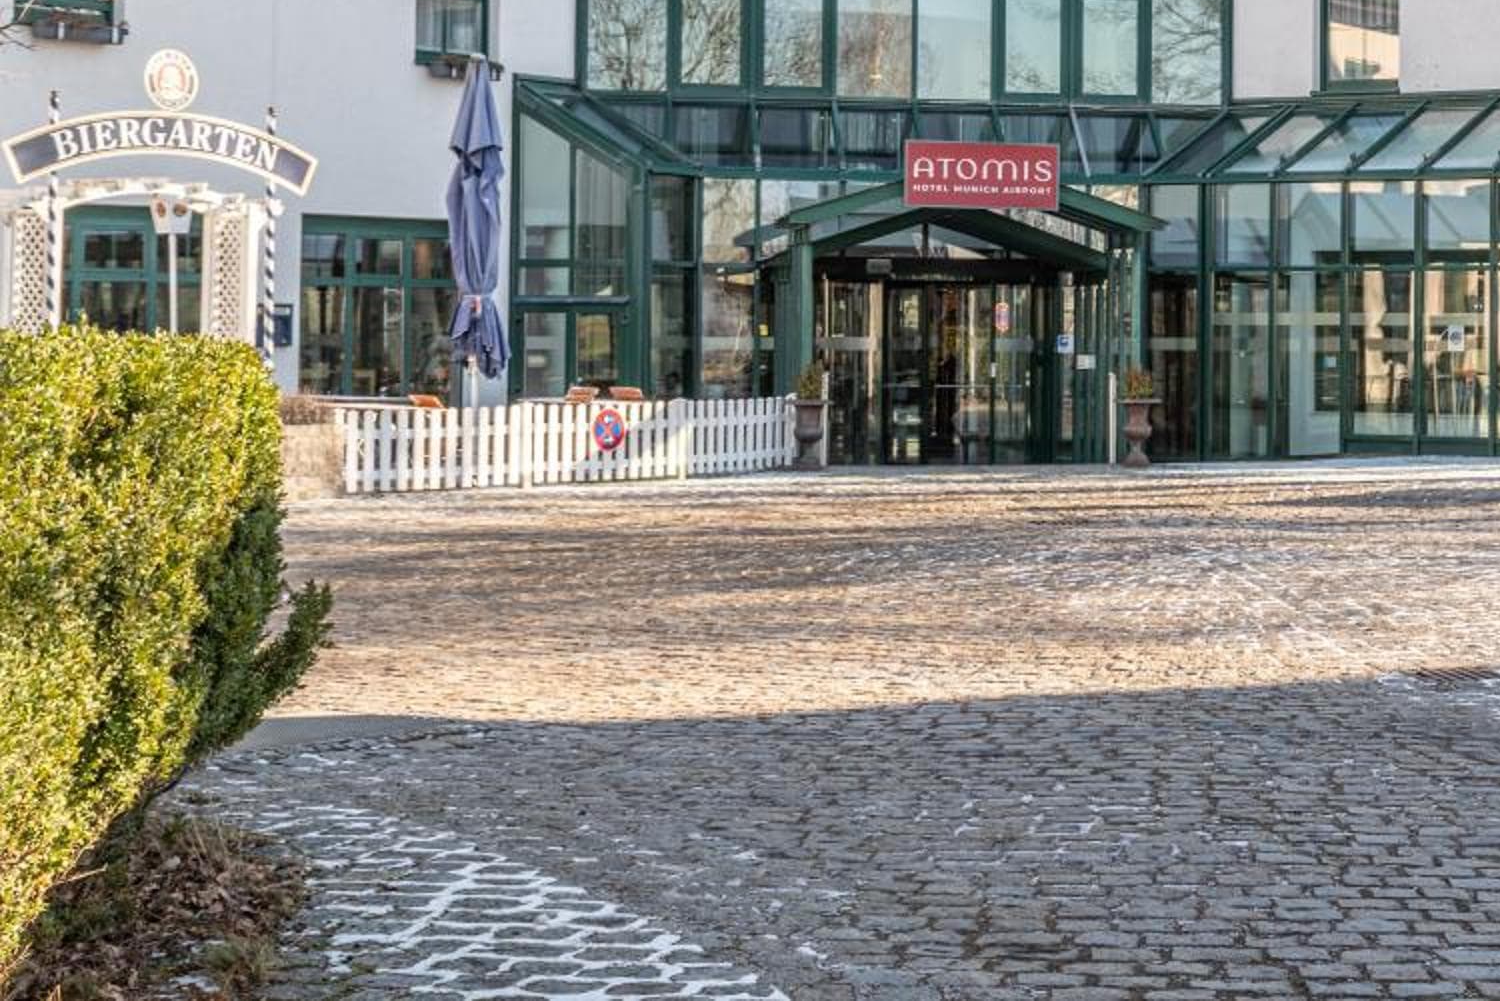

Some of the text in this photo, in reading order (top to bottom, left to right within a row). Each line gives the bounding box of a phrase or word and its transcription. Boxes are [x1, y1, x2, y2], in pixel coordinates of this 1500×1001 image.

[50, 117, 281, 173] BIERGARTEN
[912, 156, 1053, 183] ATOMIS
[912, 183, 1052, 195] HOTEL MUNICH AIRPORT
